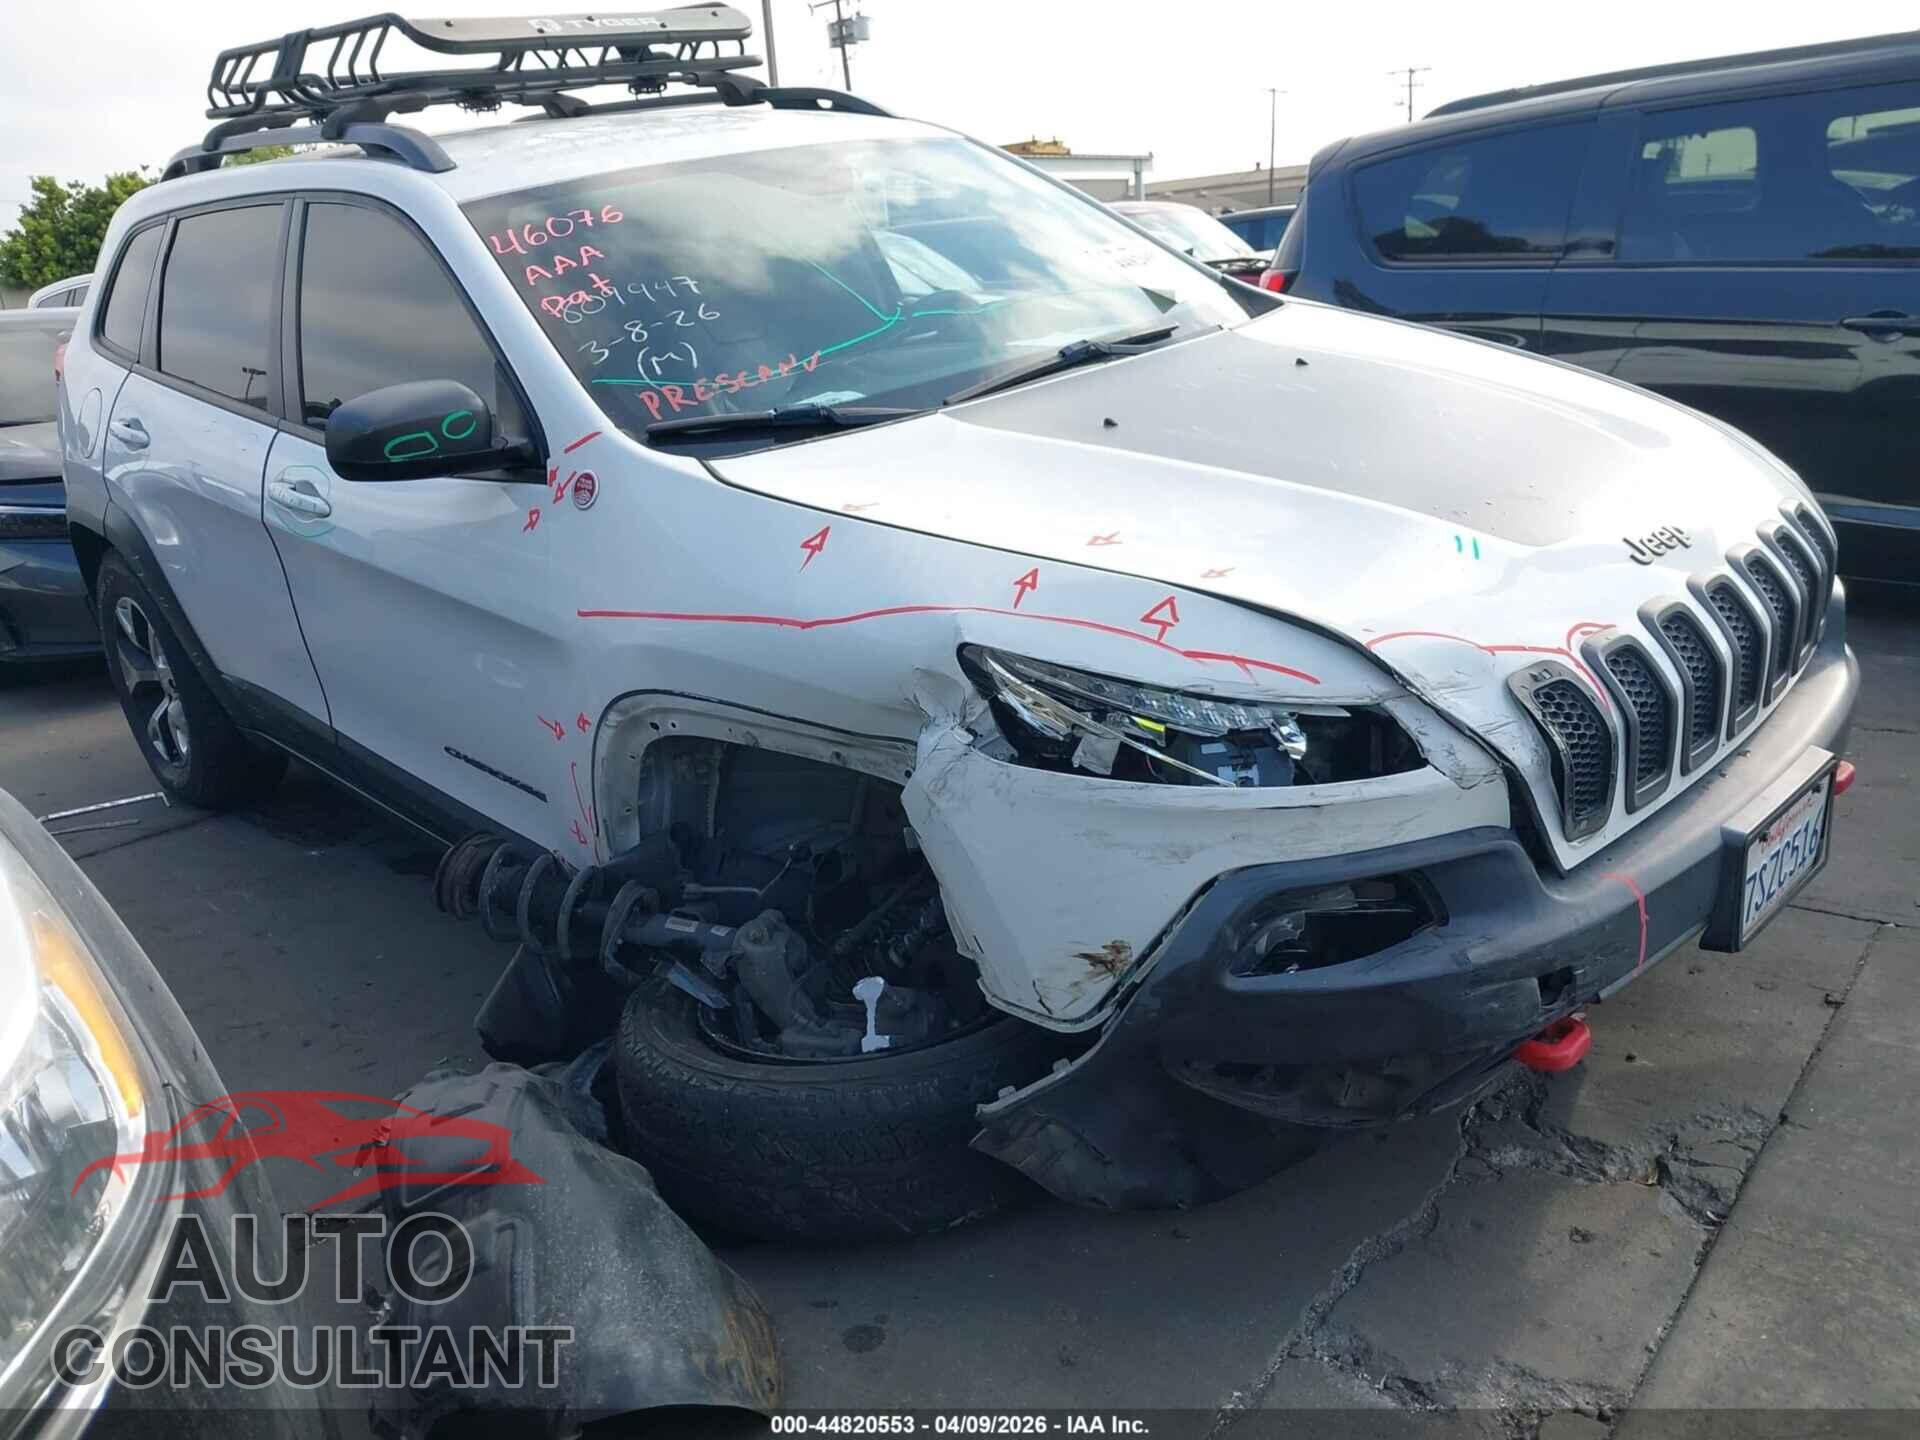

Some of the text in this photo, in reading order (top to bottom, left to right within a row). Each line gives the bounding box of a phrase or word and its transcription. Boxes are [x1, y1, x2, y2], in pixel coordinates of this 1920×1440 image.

[564, 17, 660, 29] TYGER
[490, 204, 624, 255] 46076
[524, 245, 605, 286] AAA
[578, 302, 721, 365] 3-8-26
[1621, 525, 1694, 566] Jeep
